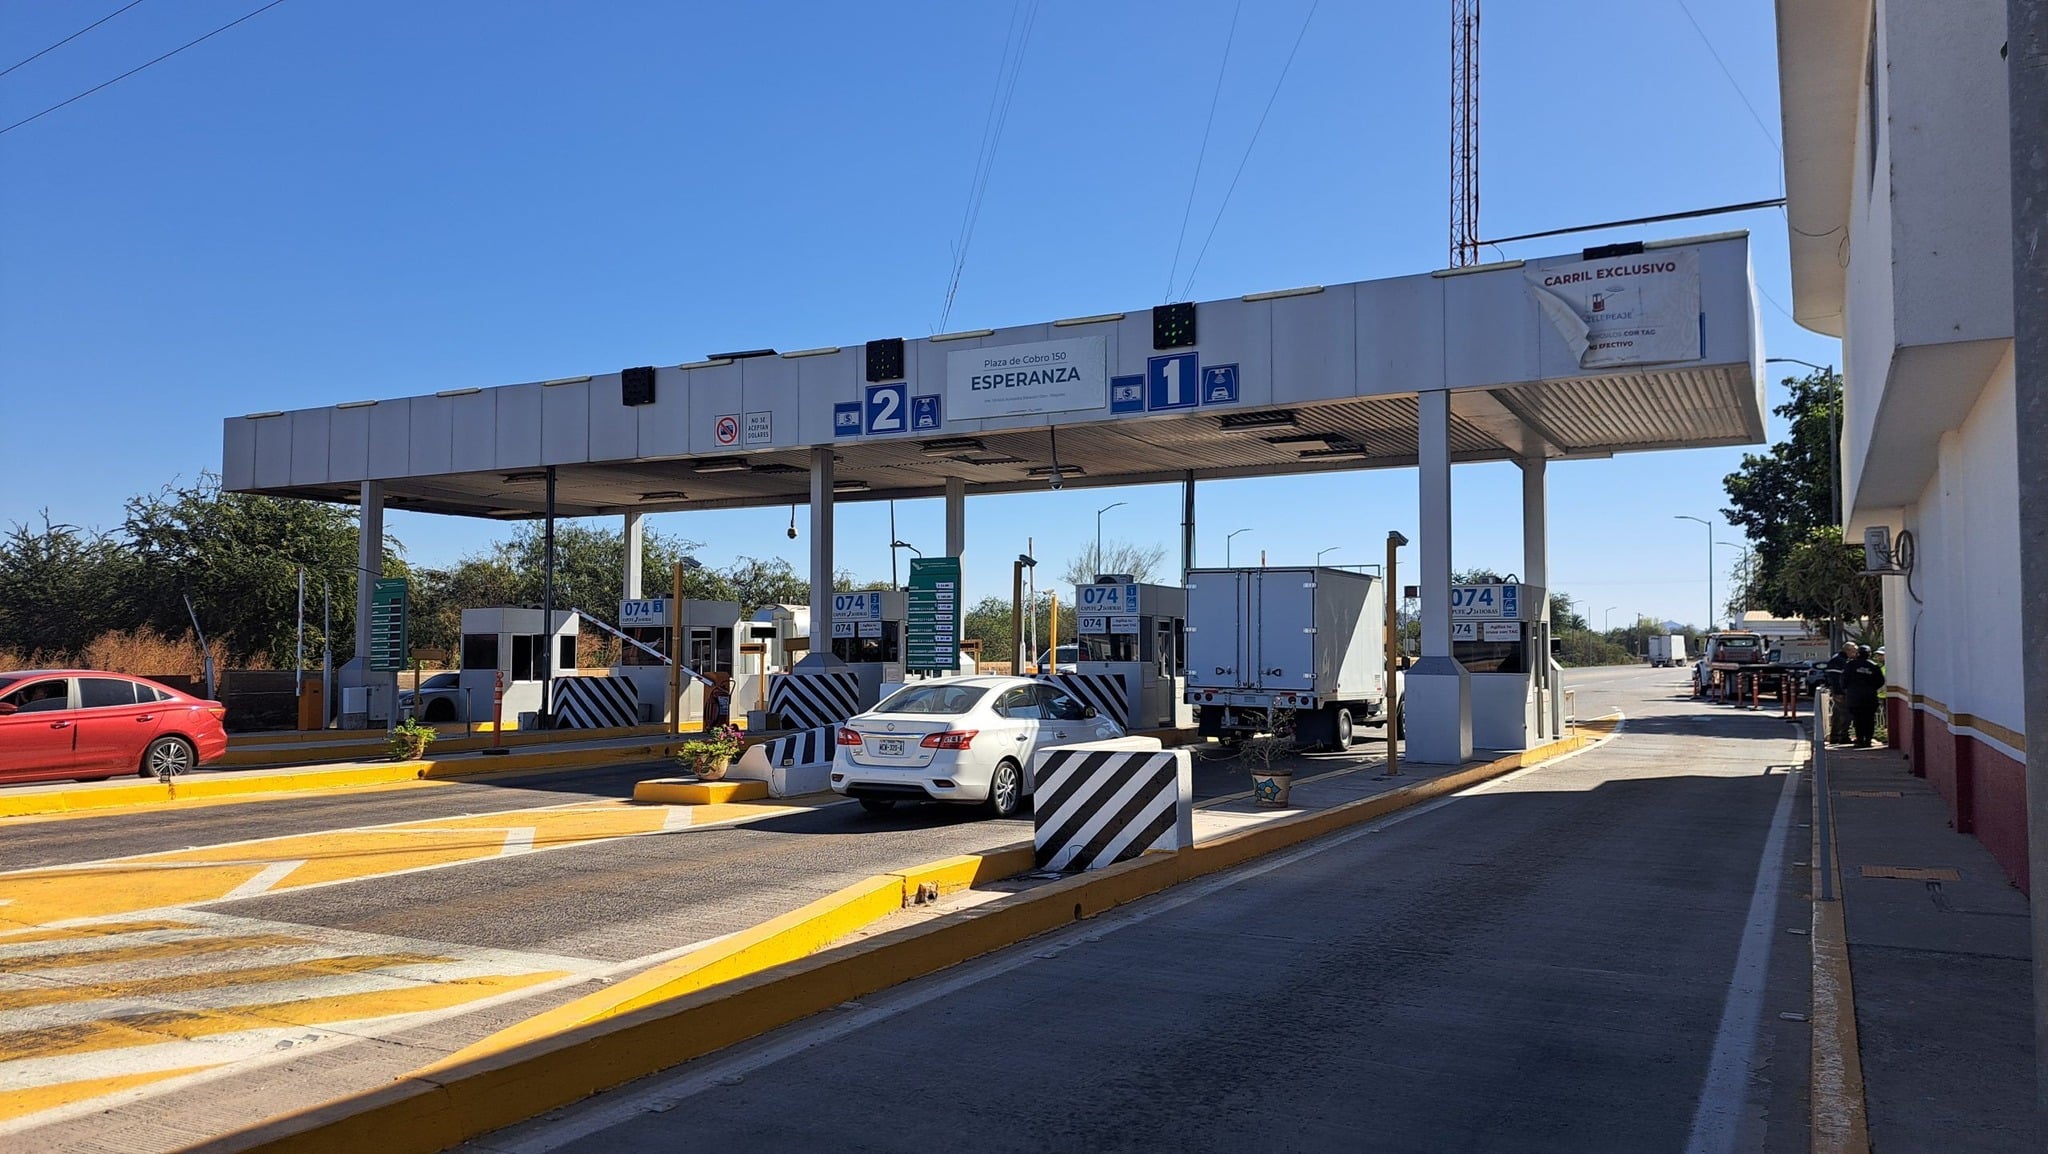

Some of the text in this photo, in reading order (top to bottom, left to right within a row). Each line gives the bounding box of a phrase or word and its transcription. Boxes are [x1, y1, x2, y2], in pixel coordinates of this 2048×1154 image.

[1544, 262, 1676, 287] CARRIL EXCLUSIVO
[1624, 329, 1640, 337] CON
[1641, 328, 1657, 336] TAG
[1599, 340, 1634, 350] EFECTIVO
[984, 351, 1067, 368] Plaza de Cobro 150
[971, 366, 1081, 392] ESPERANZA
[1163, 359, 1180, 404] 1
[872, 389, 900, 430] 2
[748, 431, 769, 439] DOLARES
[835, 595, 865, 610] 074
[1084, 588, 1119, 604] 074
[1452, 588, 1494, 607] 074
[625, 602, 650, 616] 074
[835, 624, 851, 633] 074
[1083, 618, 1102, 628] 074
[1453, 623, 1472, 635] 74
